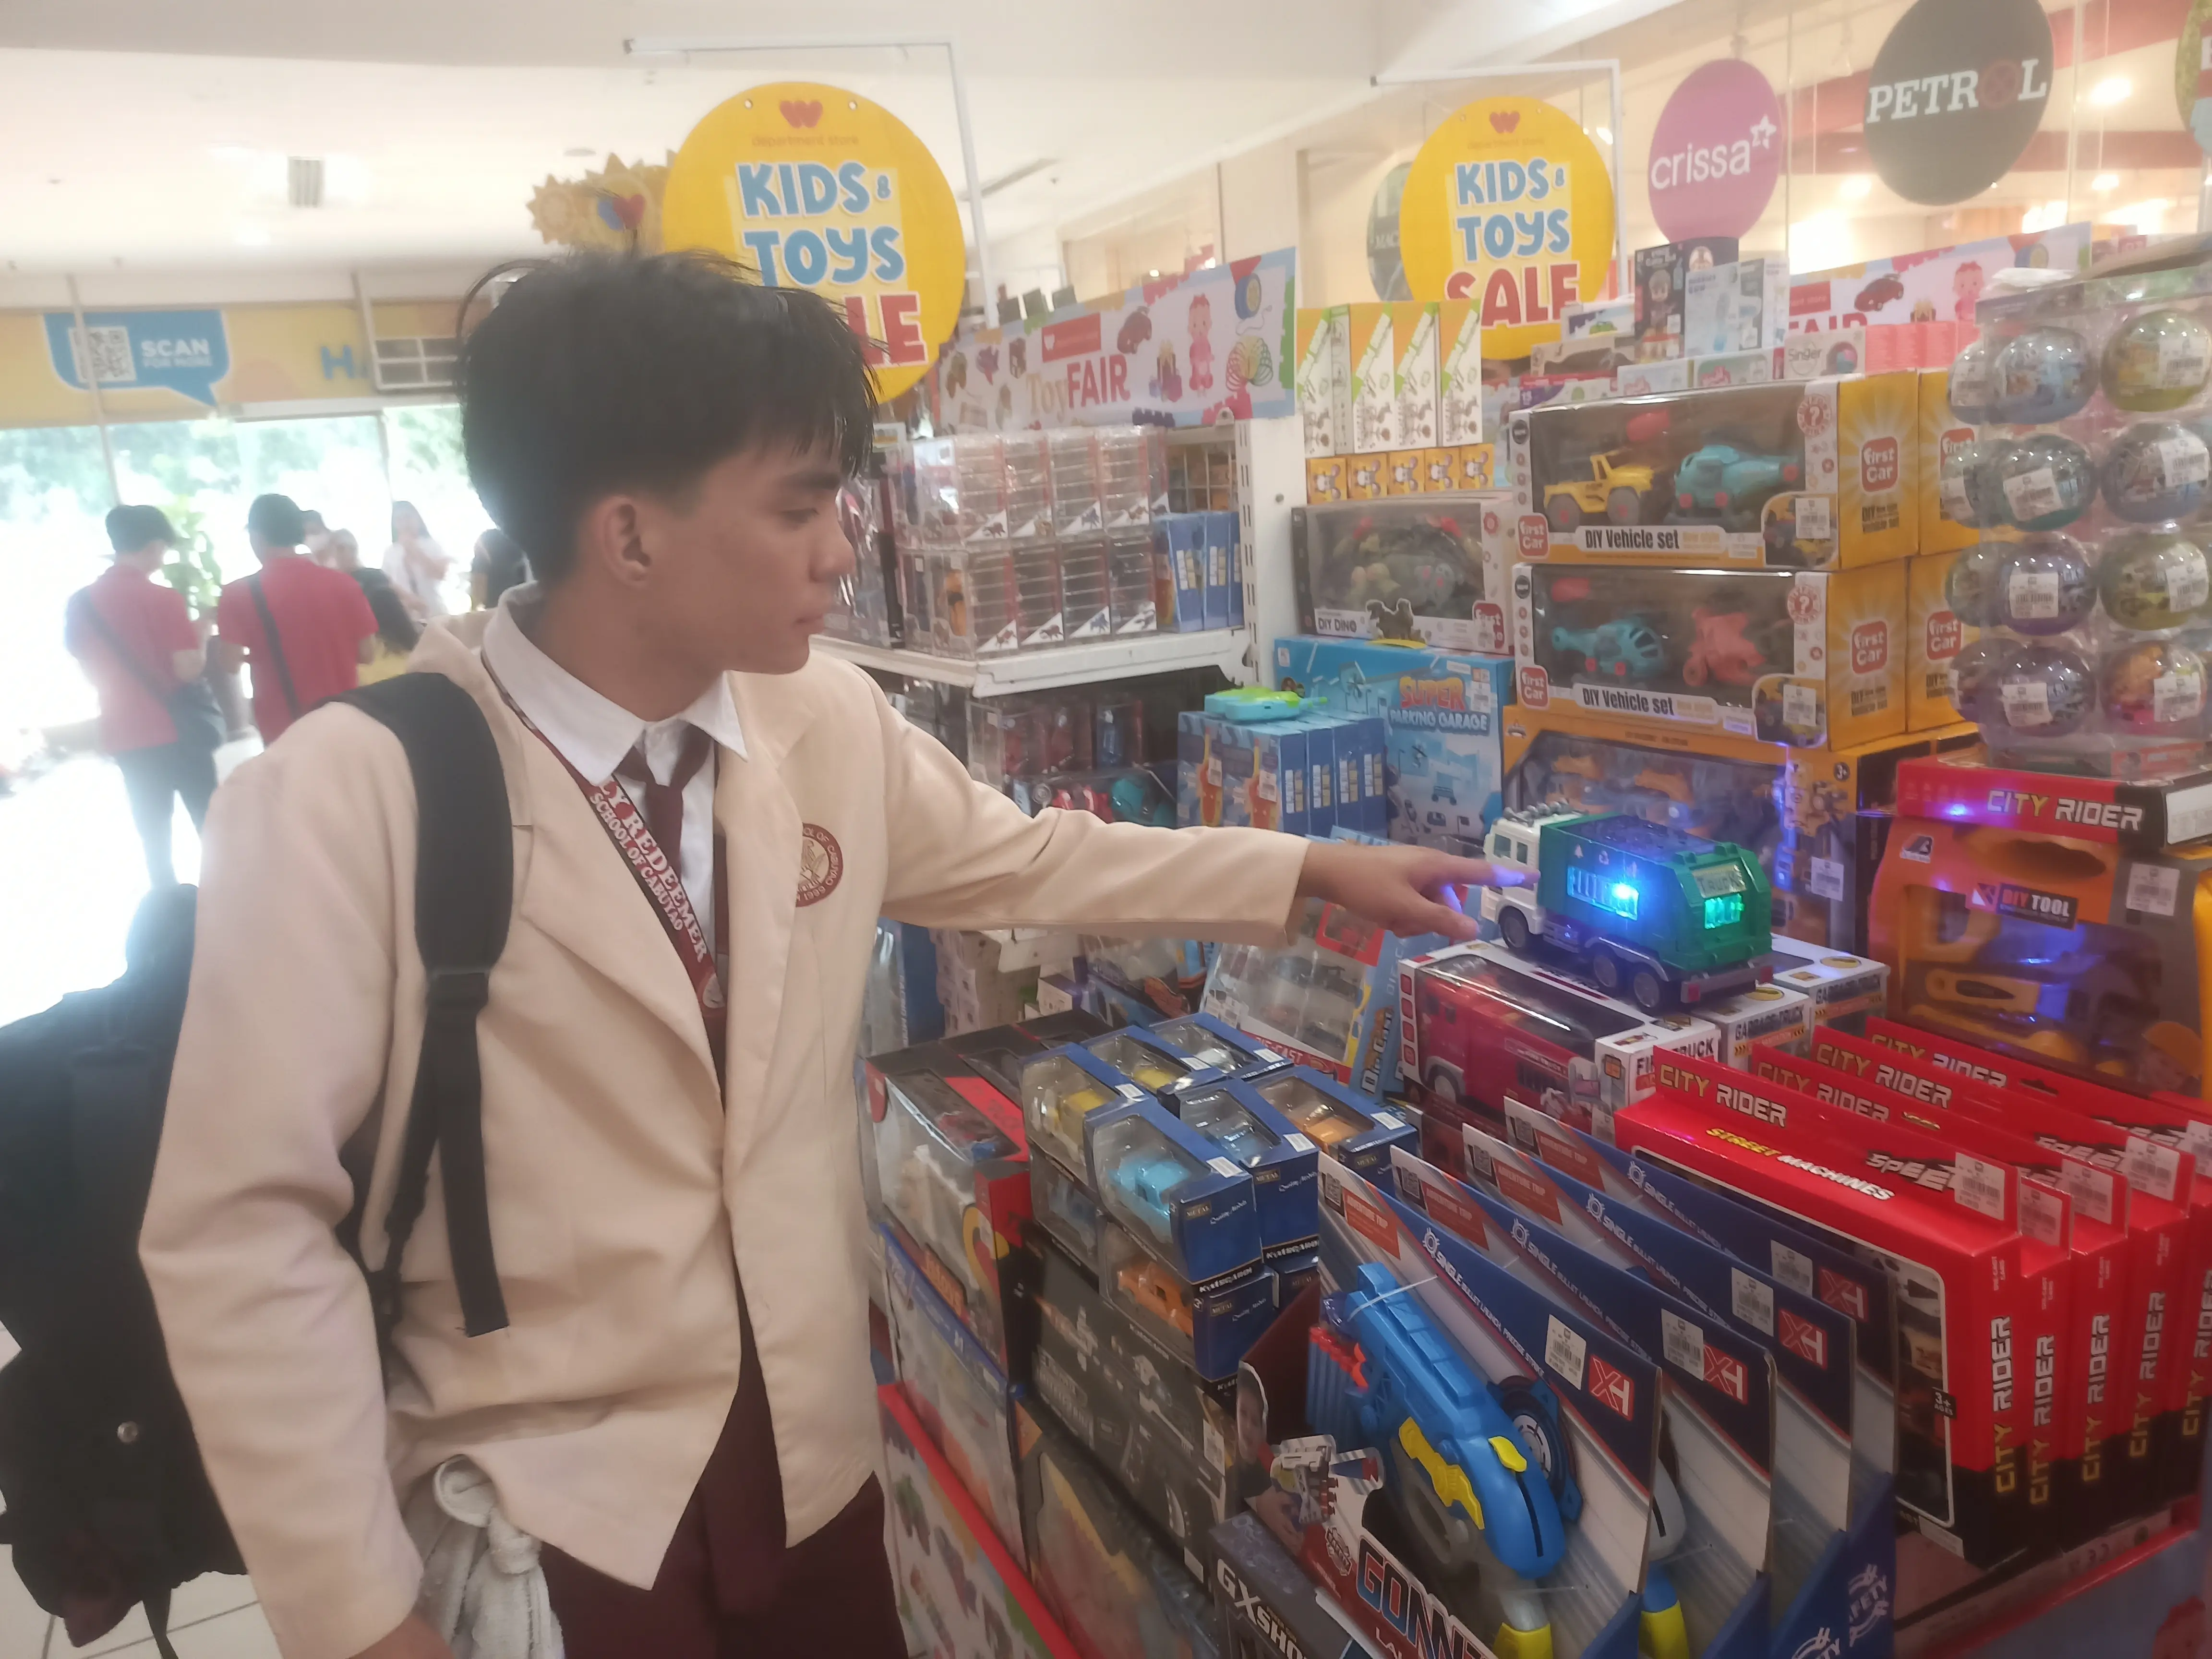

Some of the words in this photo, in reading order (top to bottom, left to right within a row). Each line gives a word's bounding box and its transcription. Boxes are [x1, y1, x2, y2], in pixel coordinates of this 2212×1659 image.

[1867, 59, 2047, 123] PETROL
[828, 134, 859, 145] store
[736, 162, 870, 217] KIDS
[1456, 158, 1549, 205] KIDS
[1651, 143, 1750, 190] crissa
[743, 226, 905, 287] TOYS
[1456, 209, 1569, 262] TOYS
[142, 338, 210, 357] SCAN
[845, 294, 927, 366] LE
[1067, 354, 1131, 409] FAIR
[1863, 447, 1895, 466] first
[1522, 537, 1544, 549] Car
[1585, 529, 1602, 549] DIY
[1606, 529, 1653, 550] Vehicle
[1657, 529, 1680, 549] set
[1318, 617, 1332, 631] DIY
[1334, 618, 1357, 633] DINO
[1929, 618, 1959, 636] first
[1931, 636, 1957, 652] Car
[1856, 649, 1883, 666] Car
[1399, 676, 1466, 712] SUPER
[1524, 686, 1544, 700] Car
[1582, 687, 1599, 707] DIY
[1602, 689, 1649, 714] Vehicle
[1652, 697, 1674, 717] set
[1390, 709, 1436, 727] PARKING
[1438, 711, 1488, 731] GARAGE
[589, 793, 632, 849] SCHOOL
[627, 847, 647, 866] OF
[1986, 789, 2051, 817] CITY
[2055, 798, 2145, 832] RIDER
[622, 810, 708, 963] REDEEMER
[2002, 892, 2030, 908] DIY
[2032, 893, 2070, 918] TOOL
[1660, 1063, 1710, 1097] CITY
[1716, 1083, 1787, 1127] RIDER
[1757, 1061, 1811, 1093] CITY
[1816, 1082, 1890, 1123] RIDER
[1816, 1043, 1871, 1077] CITY
[1875, 1064, 1952, 1108] RIDER
[1706, 1128, 1783, 1157] STREET
[1777, 1154, 1896, 1201] MACHINES
[1644, 1181, 1675, 1213] SINGLE
[1602, 1214, 1635, 1248] SINGLE
[1436, 1253, 1463, 1286] SINGLE
[1527, 1242, 1558, 1274] SINGLE
[2087, 1313, 2110, 1405] RIDER
[2139, 1291, 2166, 1381] RIDER
[1990, 1315, 2013, 1413] RIDER
[2033, 1334, 2056, 1427] RIDER
[1935, 1392, 1952, 1407] 3+
[2182, 1370, 2205, 1436] CITY
[2128, 1393, 2152, 1458] CITY
[1994, 1423, 2016, 1493] CITY
[2029, 1439, 2050, 1505] CITY
[2081, 1417, 2102, 1482] CITY
